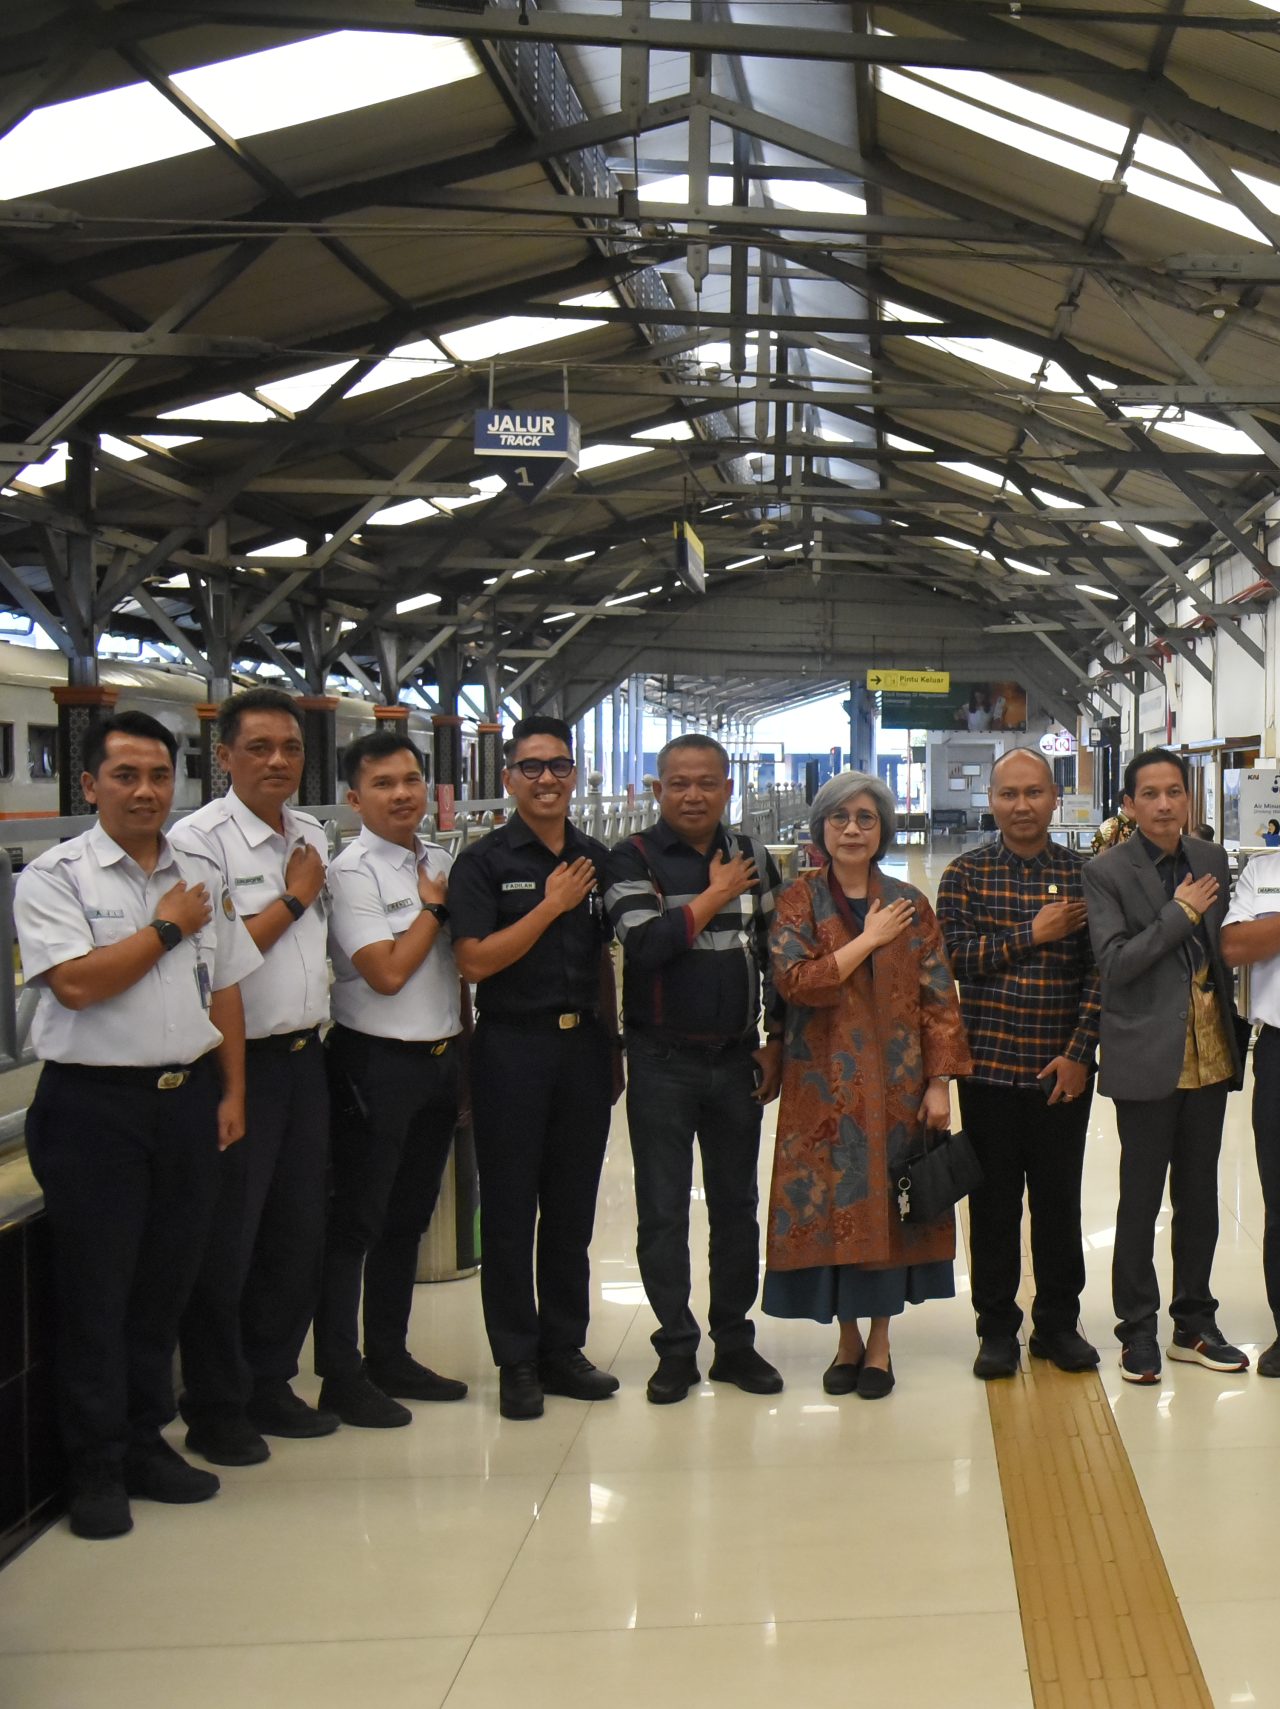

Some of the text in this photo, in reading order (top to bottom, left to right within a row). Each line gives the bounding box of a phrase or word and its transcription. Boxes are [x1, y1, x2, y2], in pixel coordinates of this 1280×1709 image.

[487, 414, 555, 433] JALUR
[499, 434, 541, 447] TRACK
[514, 466, 534, 487] 1
[899, 675, 944, 684] Pintu Keluar
